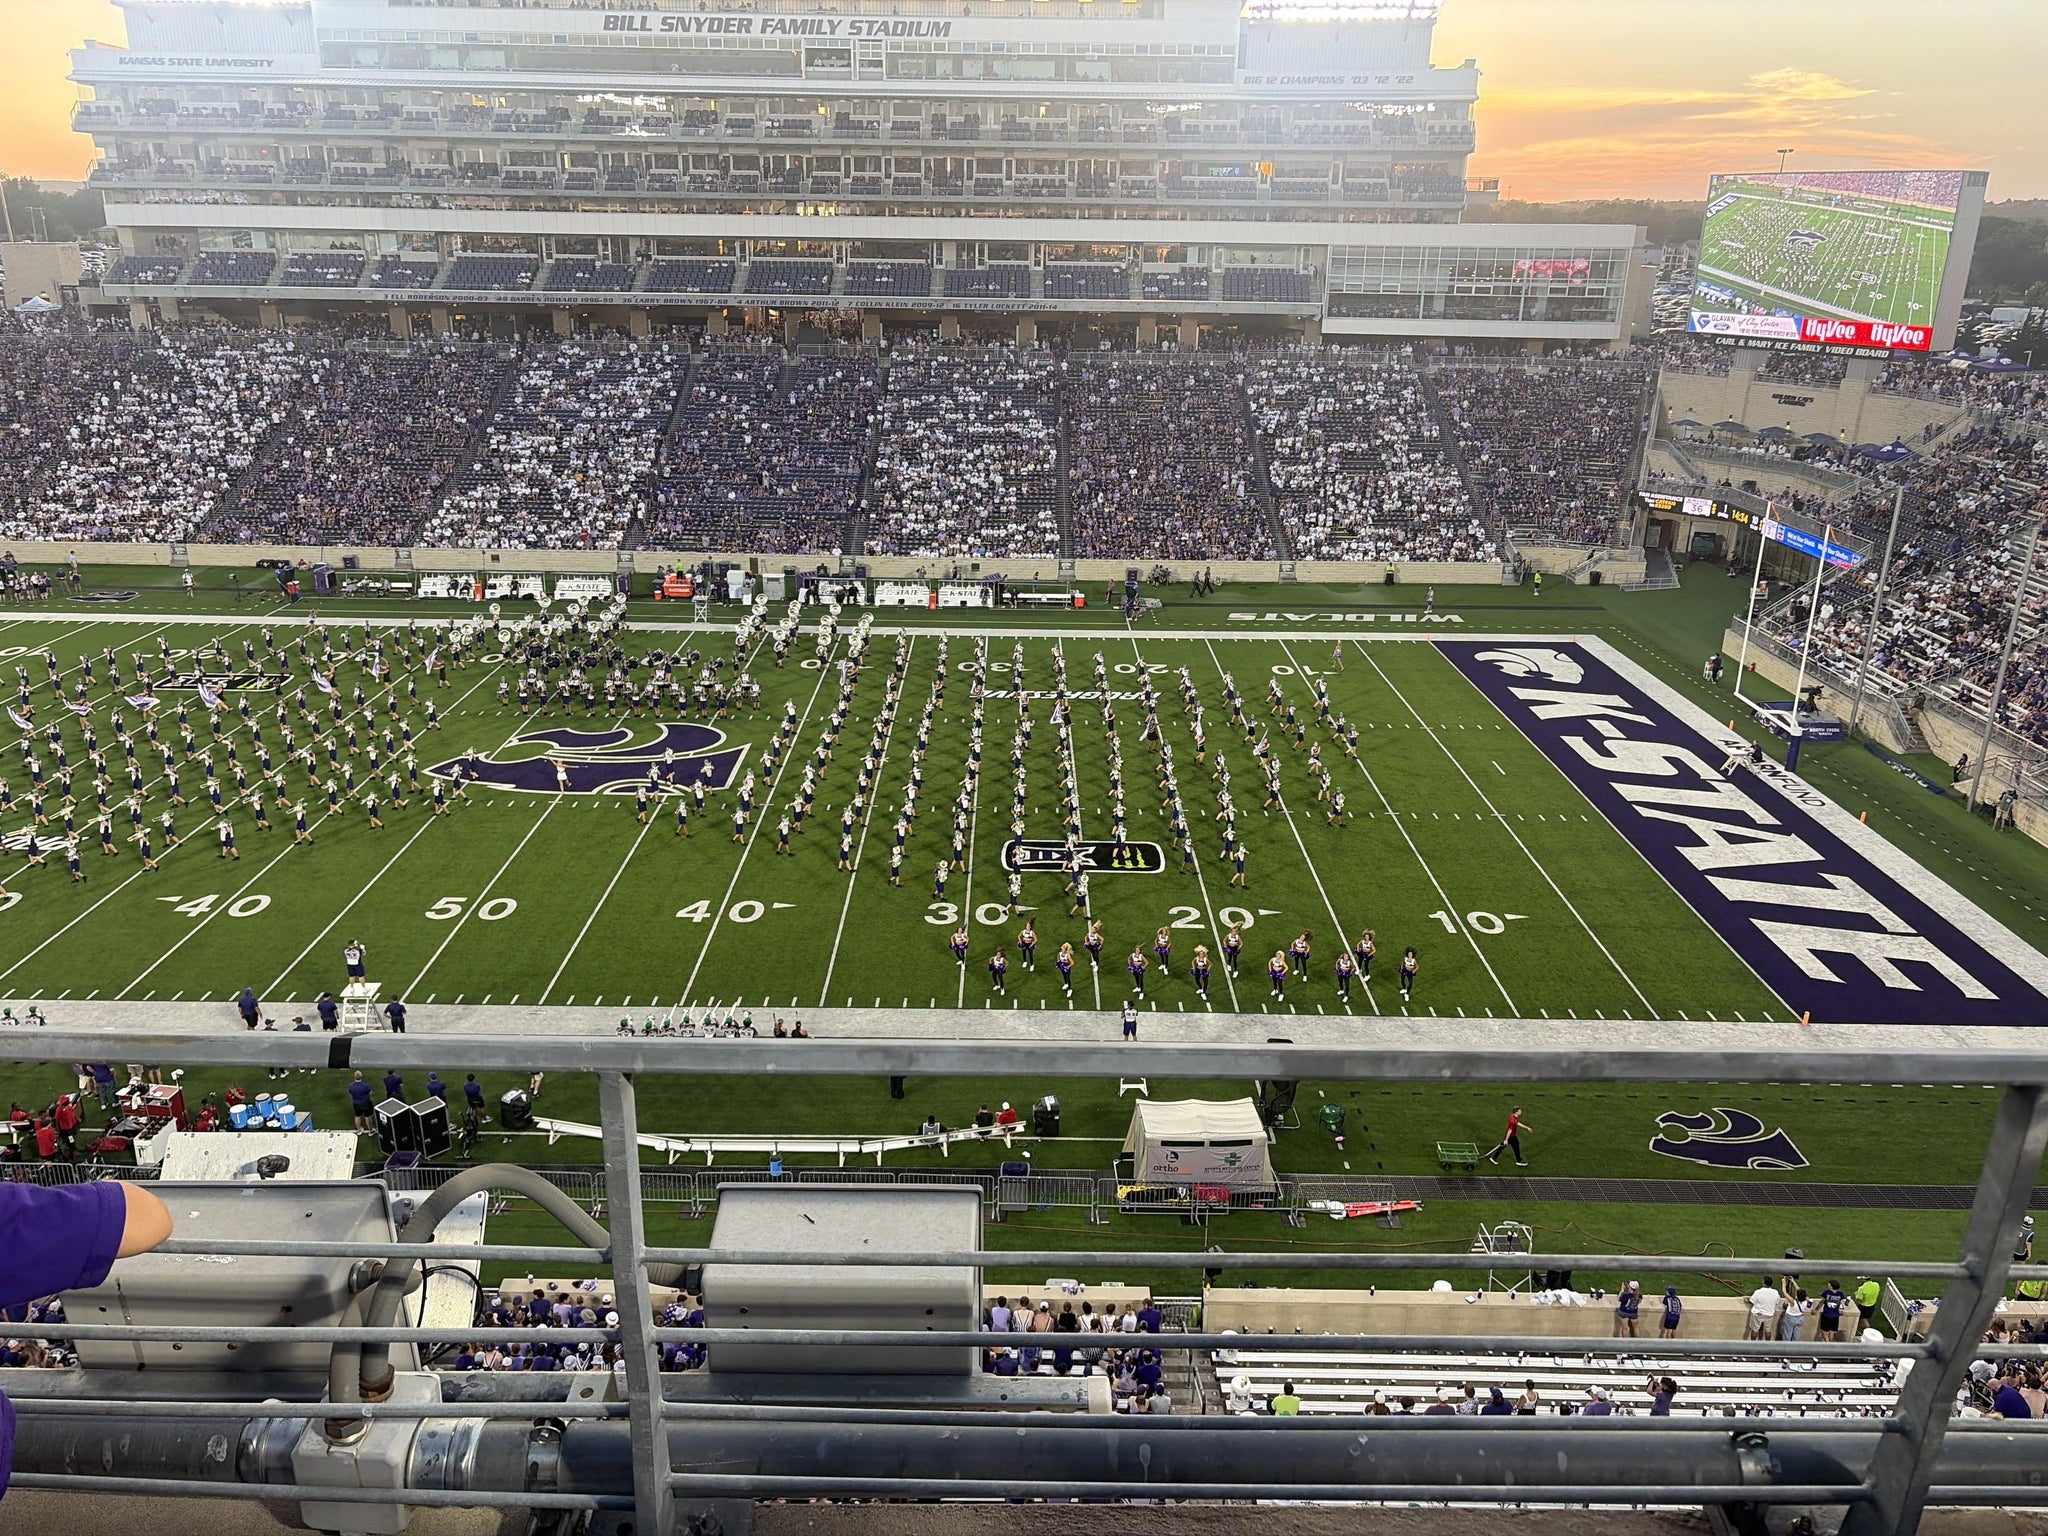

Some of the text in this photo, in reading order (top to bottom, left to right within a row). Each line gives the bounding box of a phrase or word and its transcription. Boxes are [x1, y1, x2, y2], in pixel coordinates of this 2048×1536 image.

[603, 14, 952, 37] BILL SNYDER FAMILY STADIUM
[118, 56, 274, 68] KANSAS STATE UNIVERSITY
[1243, 75, 1262, 85] BIG
[1265, 75, 1278, 85] 12
[1280, 75, 1345, 85] CHAMPIONS
[779, 299, 809, 307] BROWN
[964, 302, 989, 310] TYLER
[1805, 319, 1856, 341] HyVee
[1870, 323, 1924, 346] HyVee
[1715, 337, 1736, 346] CARL
[1747, 340, 1772, 348] MARY
[1774, 342, 1789, 350] ICE
[1789, 343, 1823, 353] FAMILY
[1825, 346, 1853, 355] VIDEO
[1855, 348, 1890, 358] BOARD
[1227, 612, 1465, 623] WILDCATS
[1113, 663, 1169, 674] 20
[1271, 664, 1320, 676] 10
[1506, 686, 2001, 1000] K-STATE
[174, 894, 272, 918] 40
[425, 897, 518, 921] 50
[676, 900, 765, 922] 40
[924, 902, 1010, 926] 30
[1168, 906, 1255, 930] 20
[1428, 911, 1506, 934] 10
